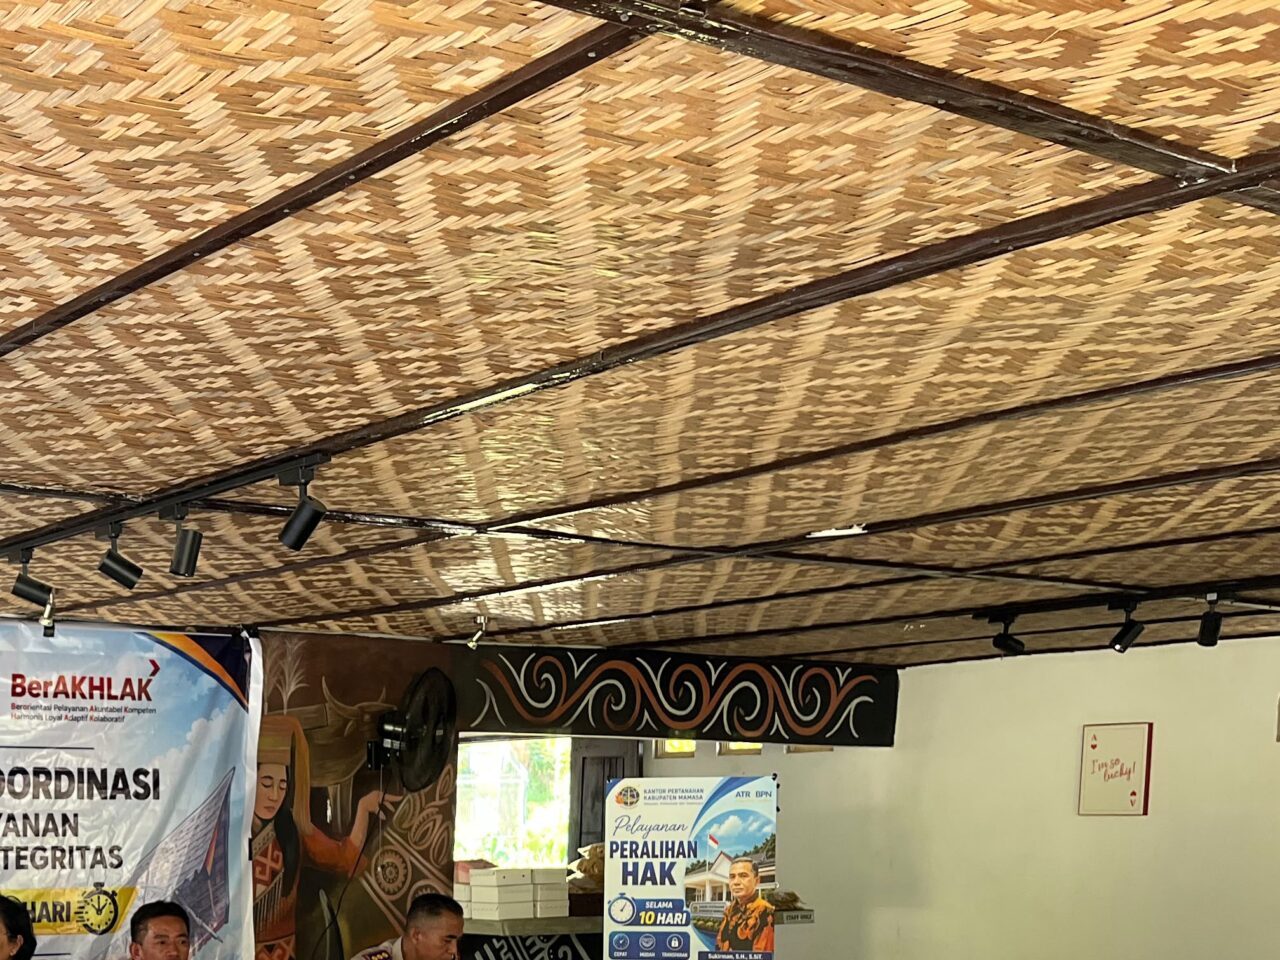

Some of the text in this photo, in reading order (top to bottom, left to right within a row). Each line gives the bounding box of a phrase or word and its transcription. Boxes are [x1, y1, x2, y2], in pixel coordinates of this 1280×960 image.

[11, 673, 153, 701] BerAKHLAK
[10, 703, 157, 715] Berorientasi Pelayanan Akuntabel Kompeten
[63, 714, 89, 723] Adaptif
[613, 814, 688, 840] Pelayanan
[609, 840, 698, 859] PERALIHAN
[621, 861, 677, 886] HAK
[645, 901, 673, 909] SELAMA
[639, 911, 687, 925] 10 HARI
